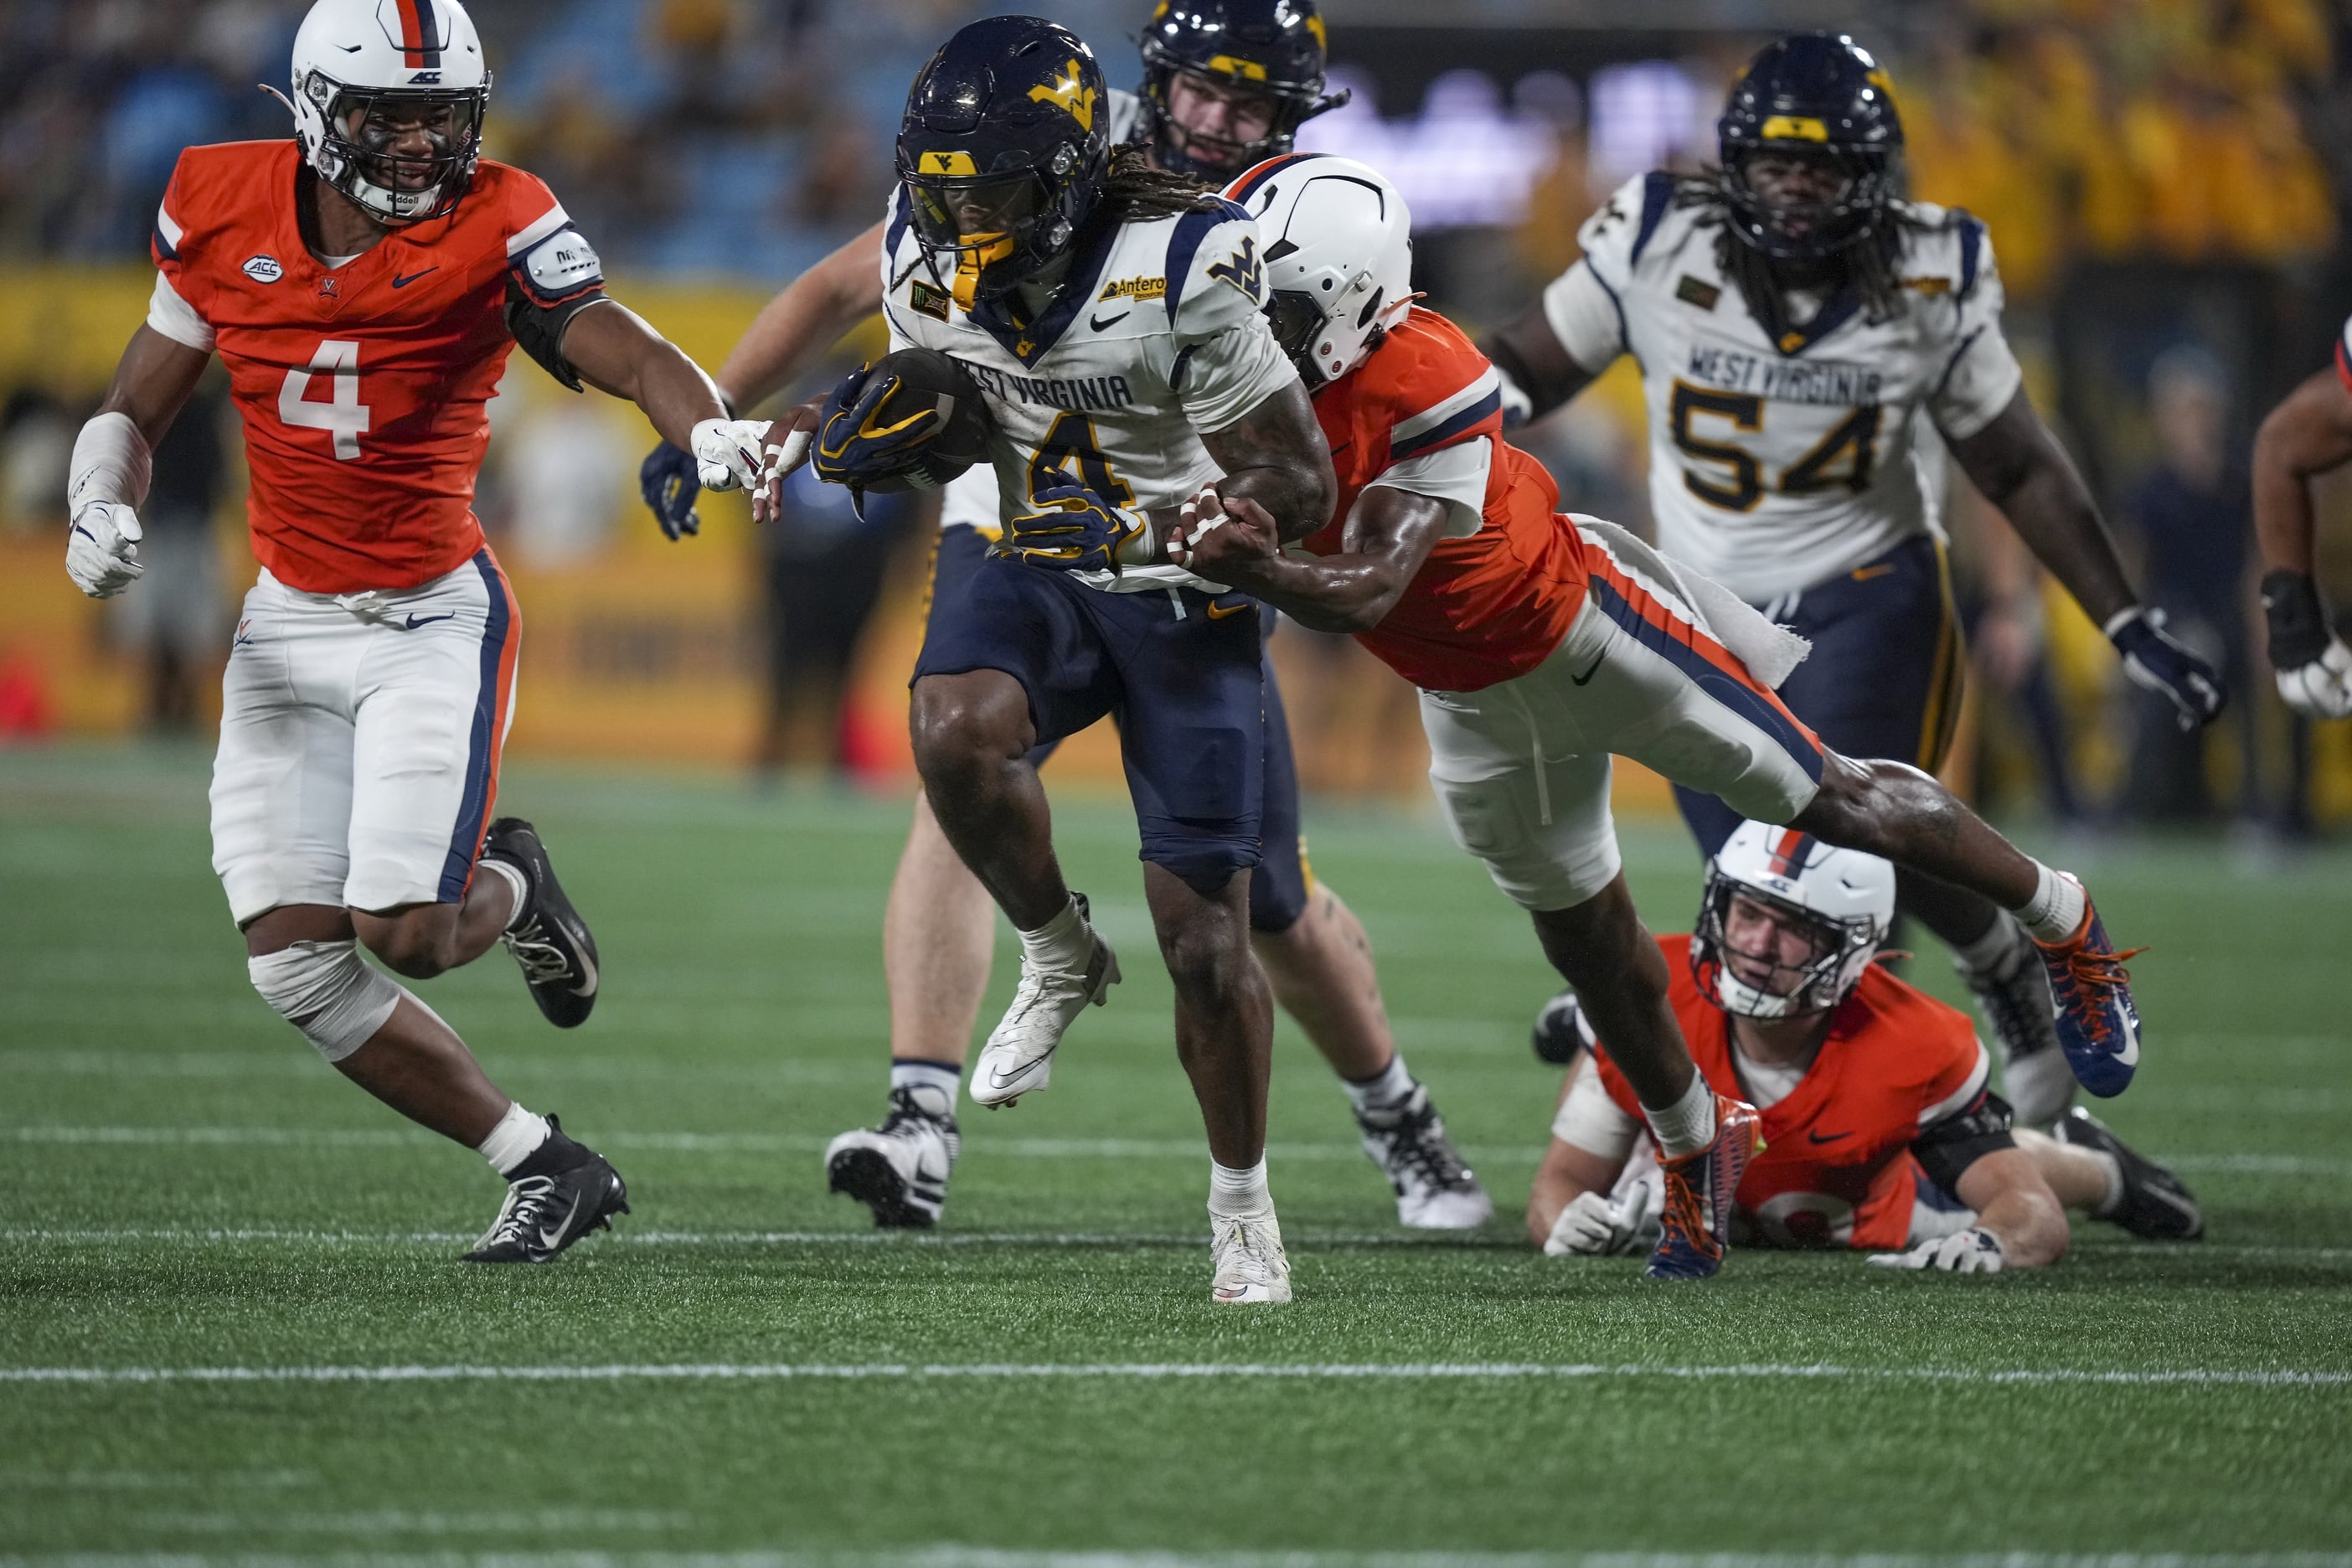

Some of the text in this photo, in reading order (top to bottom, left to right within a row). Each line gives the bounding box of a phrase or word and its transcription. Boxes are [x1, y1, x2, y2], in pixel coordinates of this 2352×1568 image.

[407, 71, 442, 85] ACC
[386, 193, 420, 204] Rddell
[249, 261, 278, 276] ACC
[1118, 275, 1166, 294] Antero
[1688, 343, 1758, 389] WEST
[279, 340, 370, 462] 4
[1006, 374, 1133, 410] VIRGINIA
[1027, 410, 1137, 511] 4
[1668, 376, 1884, 513] 54
